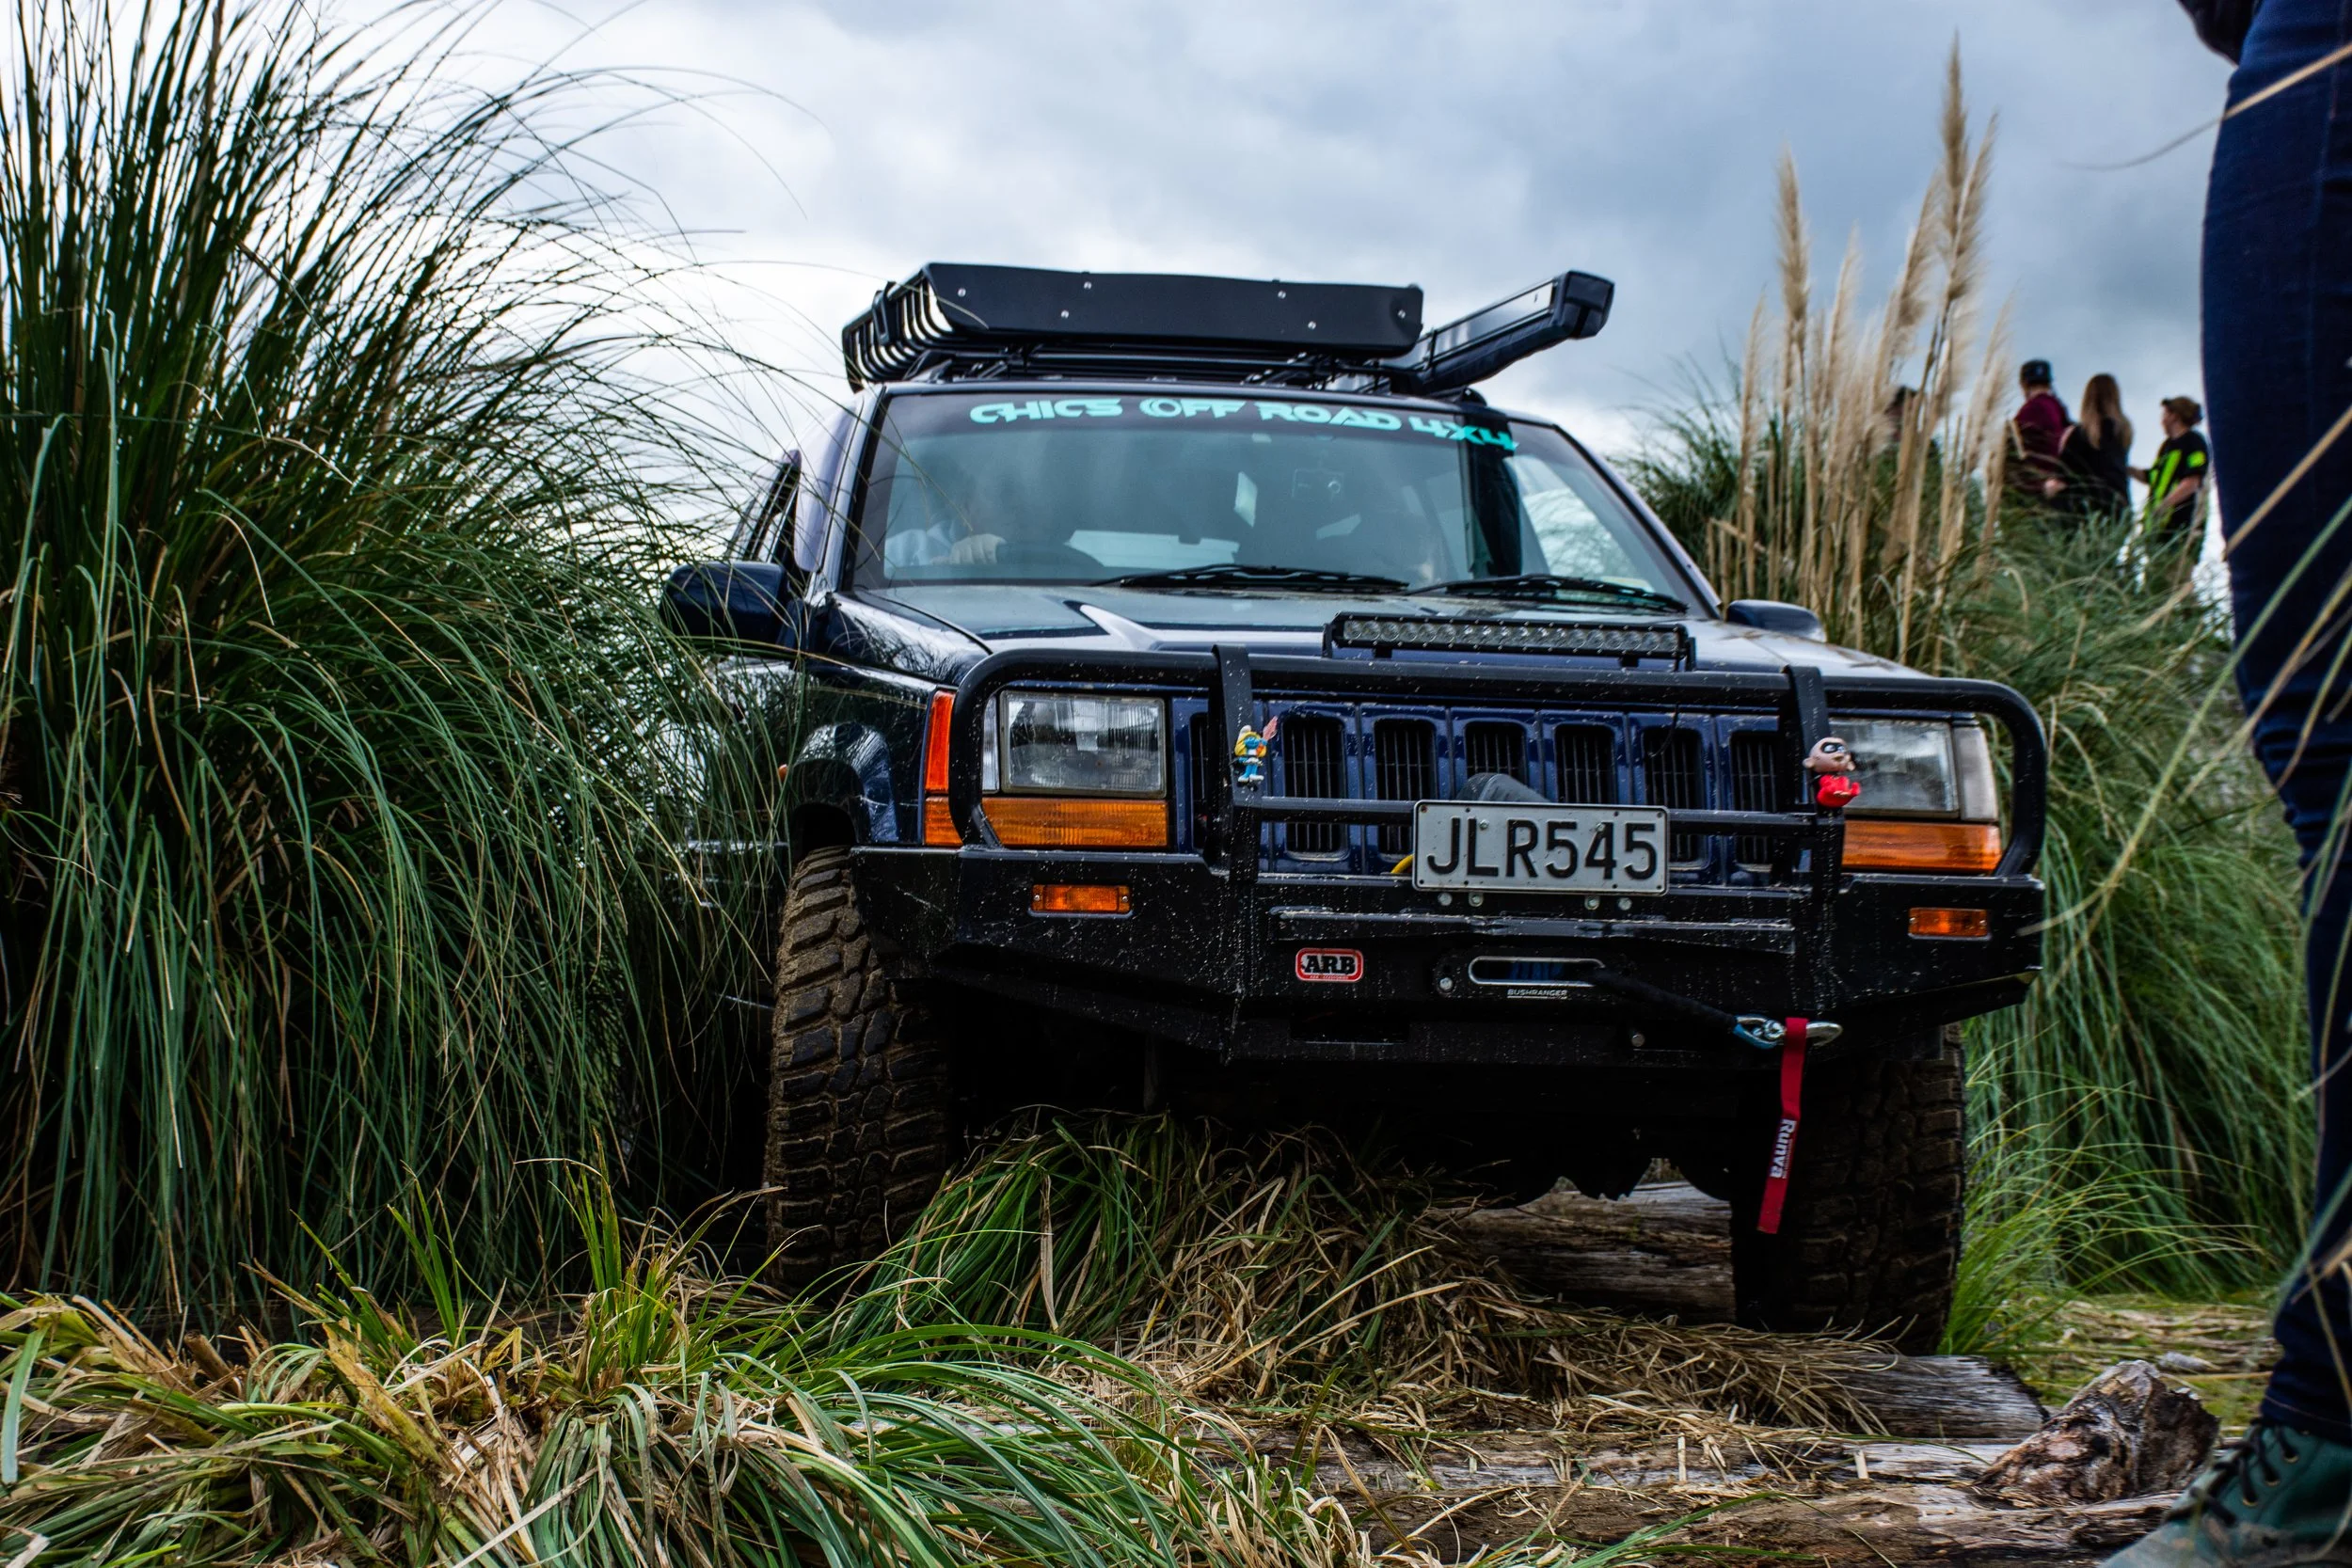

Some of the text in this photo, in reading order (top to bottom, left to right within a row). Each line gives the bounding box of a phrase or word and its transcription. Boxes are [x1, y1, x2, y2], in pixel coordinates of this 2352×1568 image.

[970, 398, 1123, 423] CHICS
[1139, 398, 1247, 419] OFF
[1255, 402, 1402, 430] ROAD
[1426, 816, 1657, 880] JLR545
[1302, 955, 1356, 974] ARB
[1507, 989, 1568, 997] BUSHRANGER
[1769, 1118, 1797, 1178] Runva
